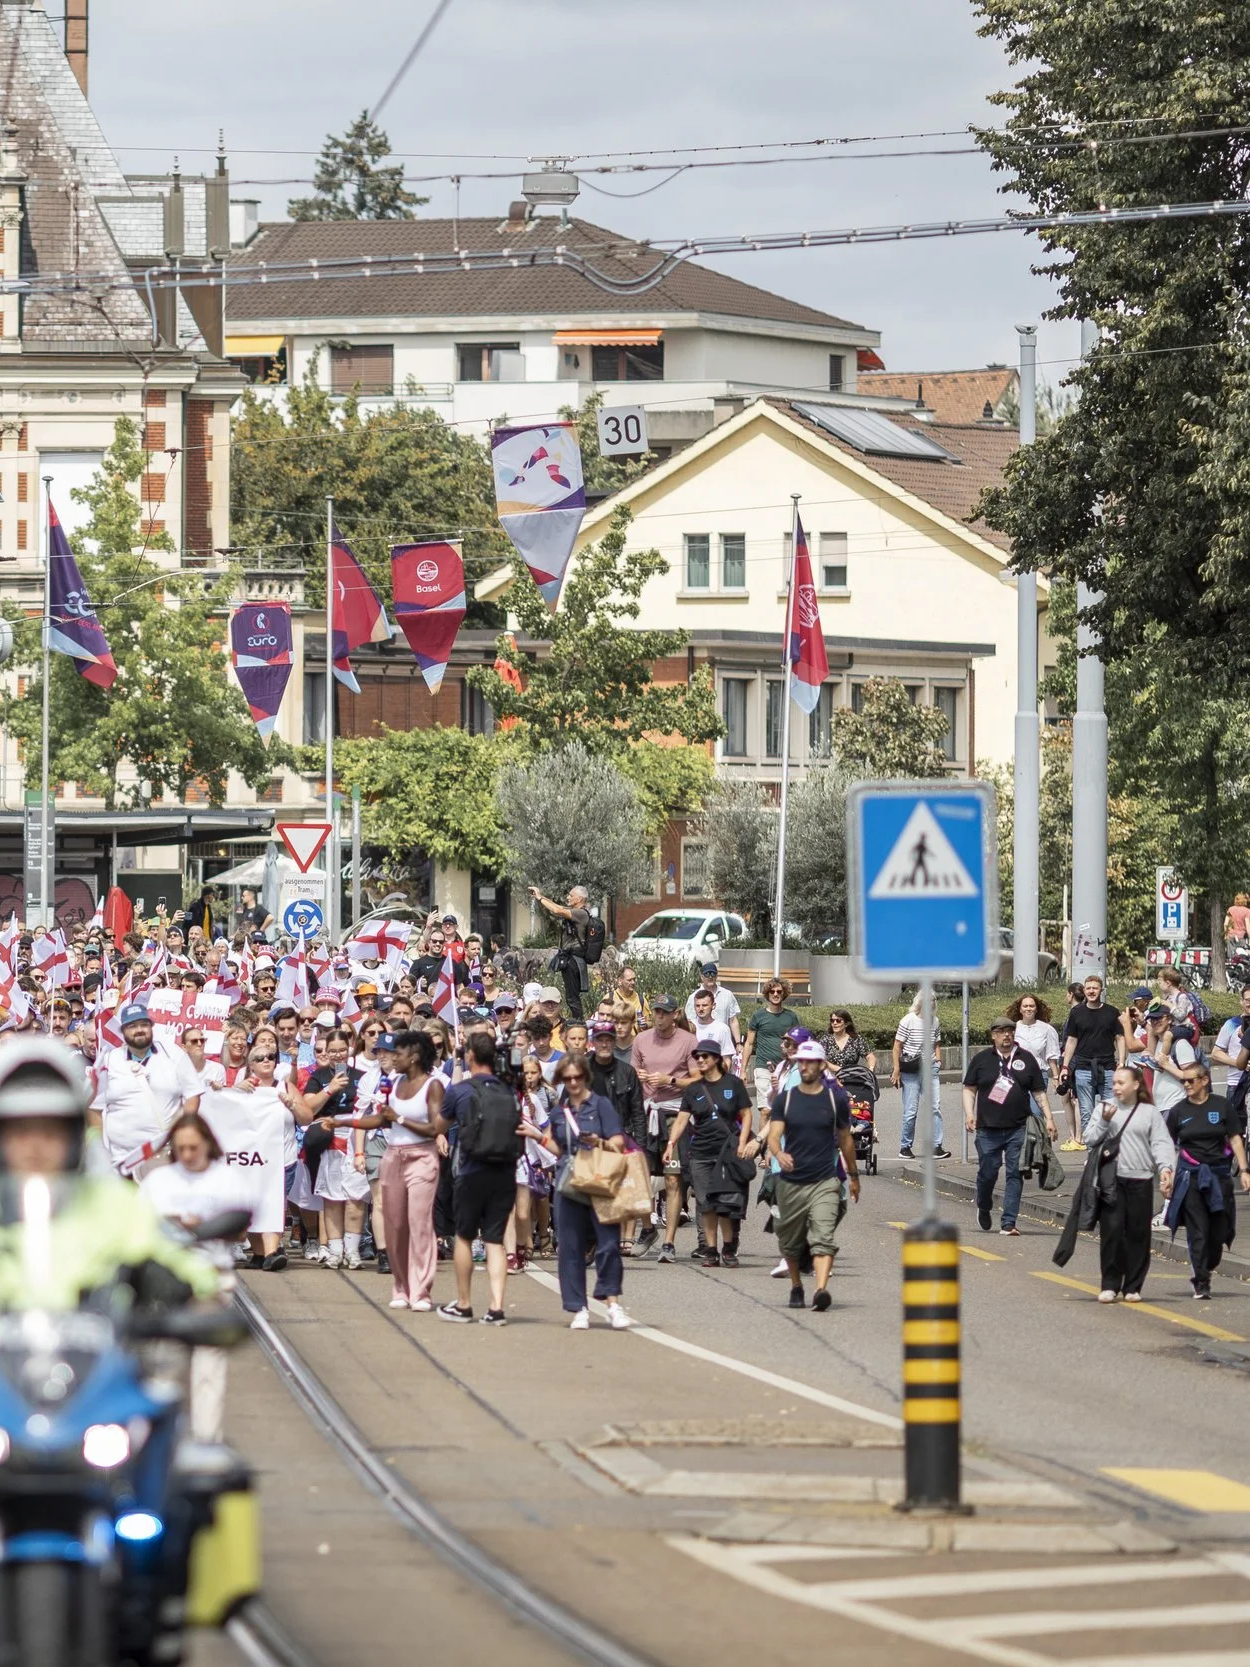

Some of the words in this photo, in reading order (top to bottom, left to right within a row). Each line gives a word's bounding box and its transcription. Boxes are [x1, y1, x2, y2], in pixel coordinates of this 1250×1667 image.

[604, 414, 642, 446] 30
[416, 583, 442, 594] Basel
[1167, 903, 1177, 917] P
[338, 1092, 347, 1107] 2
